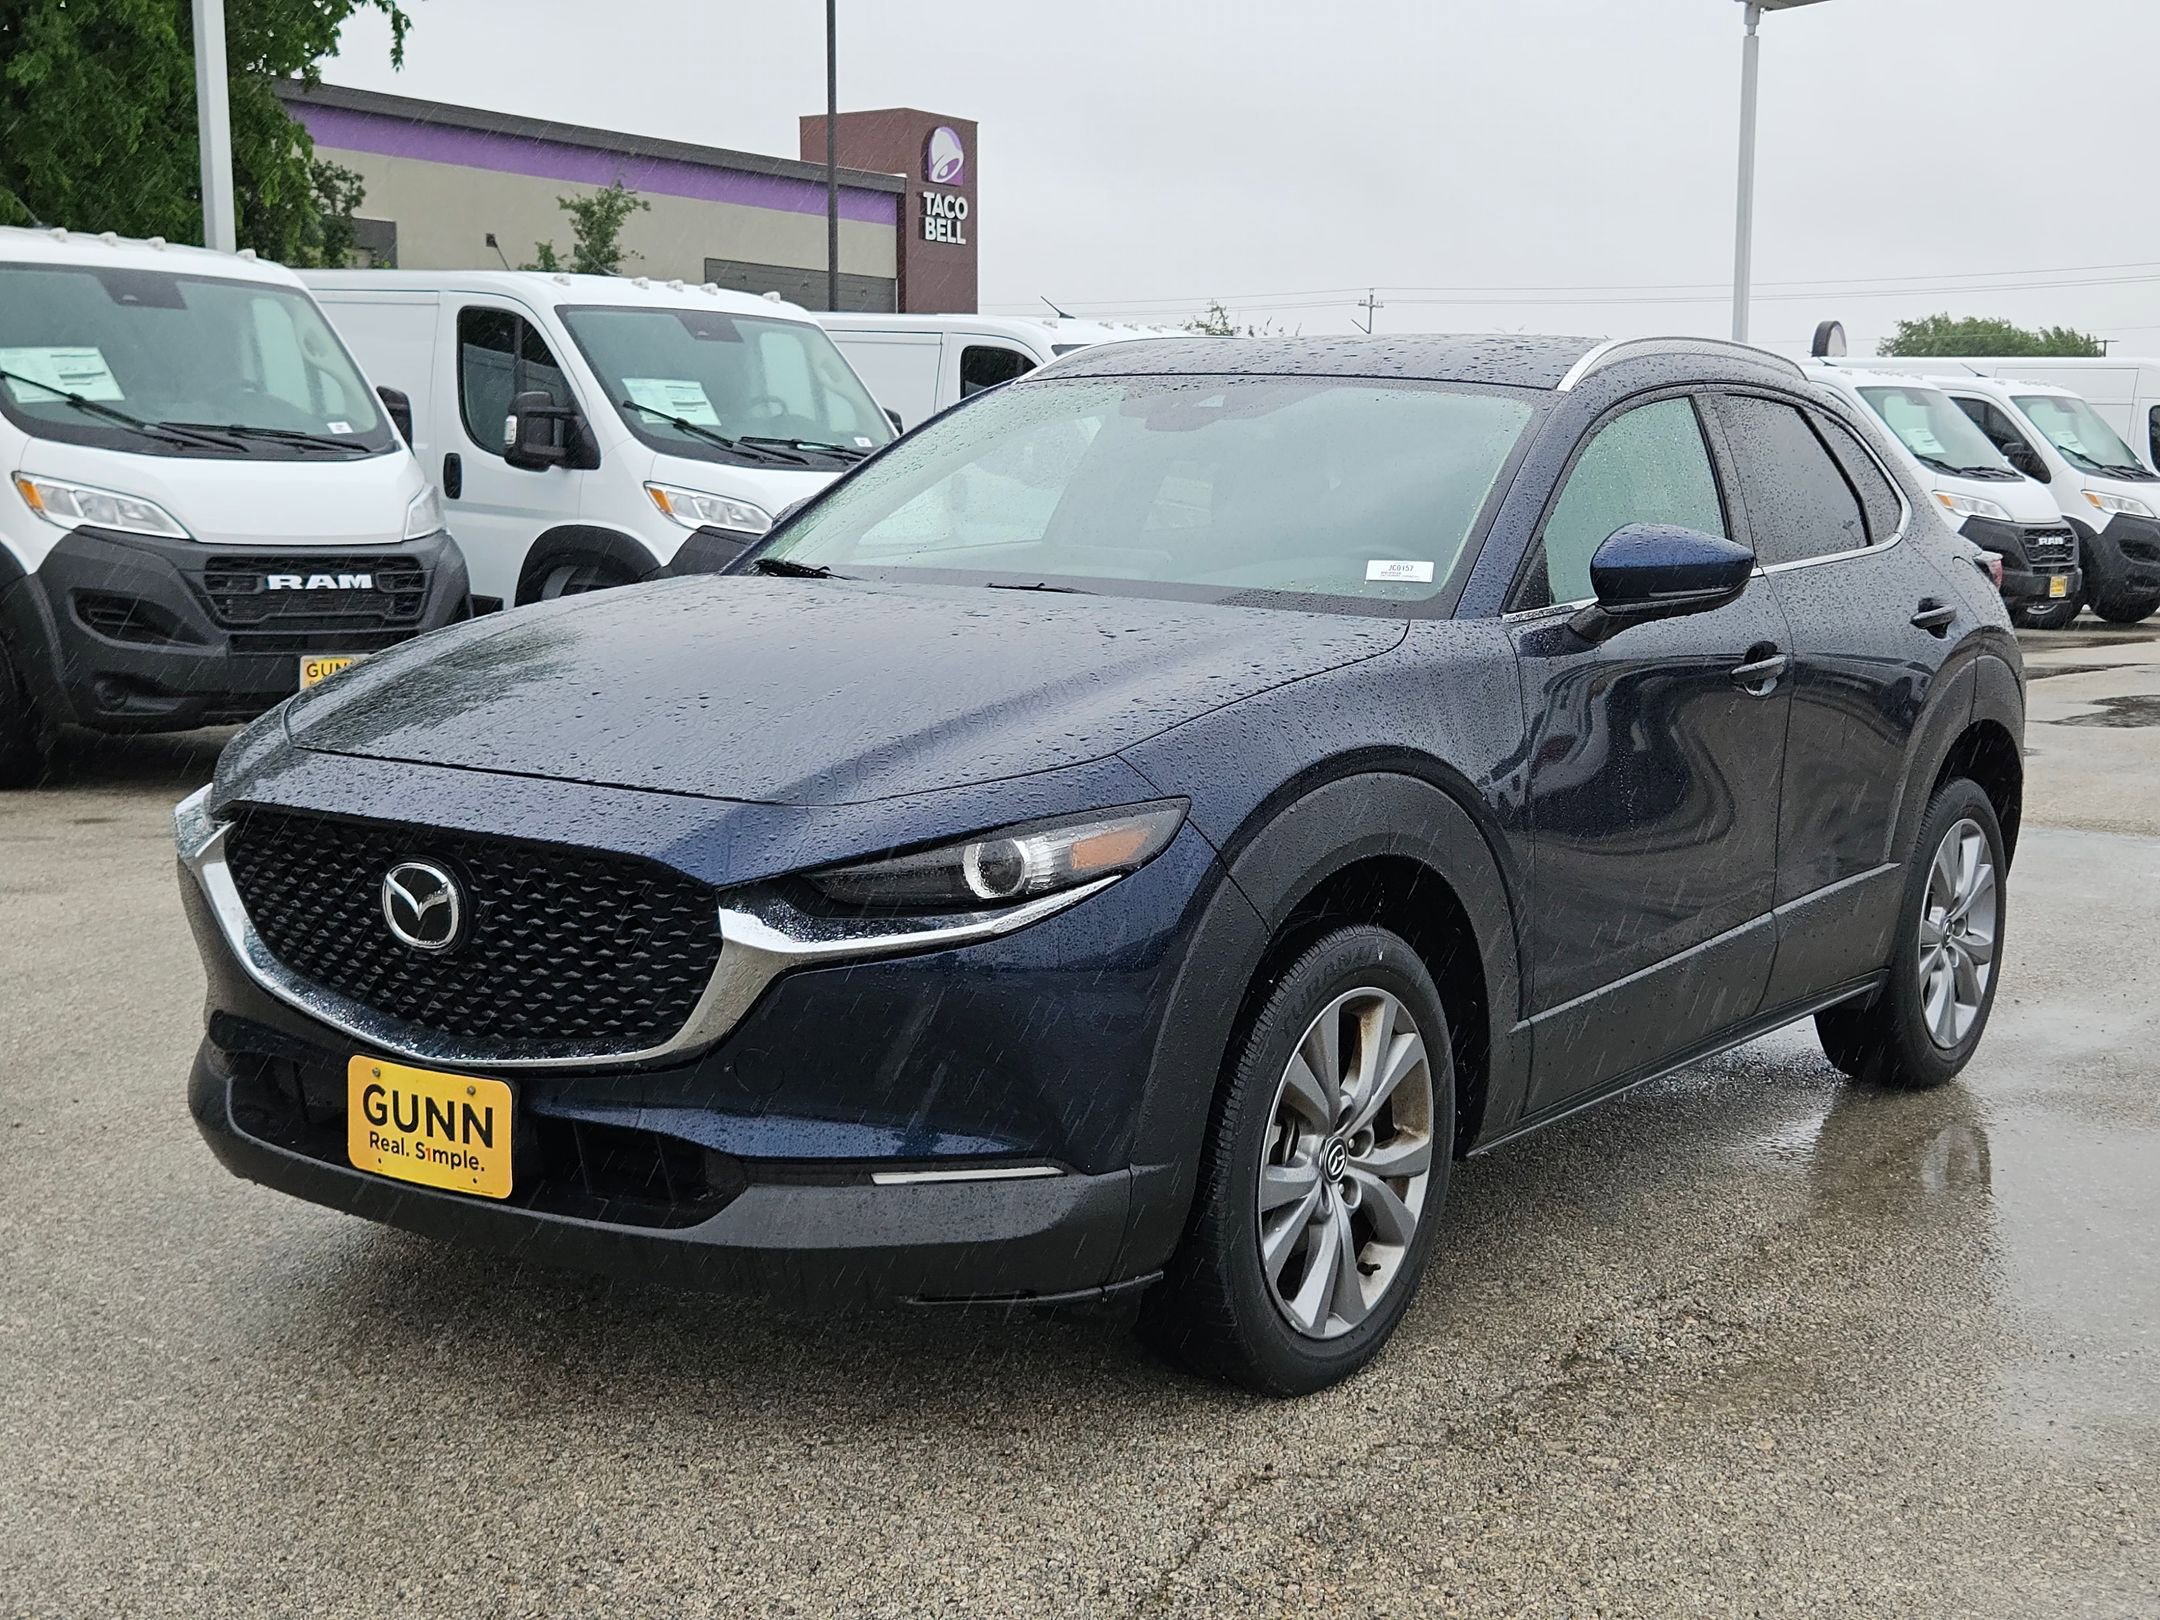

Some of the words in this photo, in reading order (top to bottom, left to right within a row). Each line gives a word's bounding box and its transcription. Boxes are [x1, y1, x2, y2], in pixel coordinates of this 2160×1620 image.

[923, 191, 968, 220] TACO
[924, 216, 967, 245] BELL
[267, 574, 373, 590] RAM
[362, 1083, 494, 1149] GUNN
[369, 1130, 410, 1158] Real.
